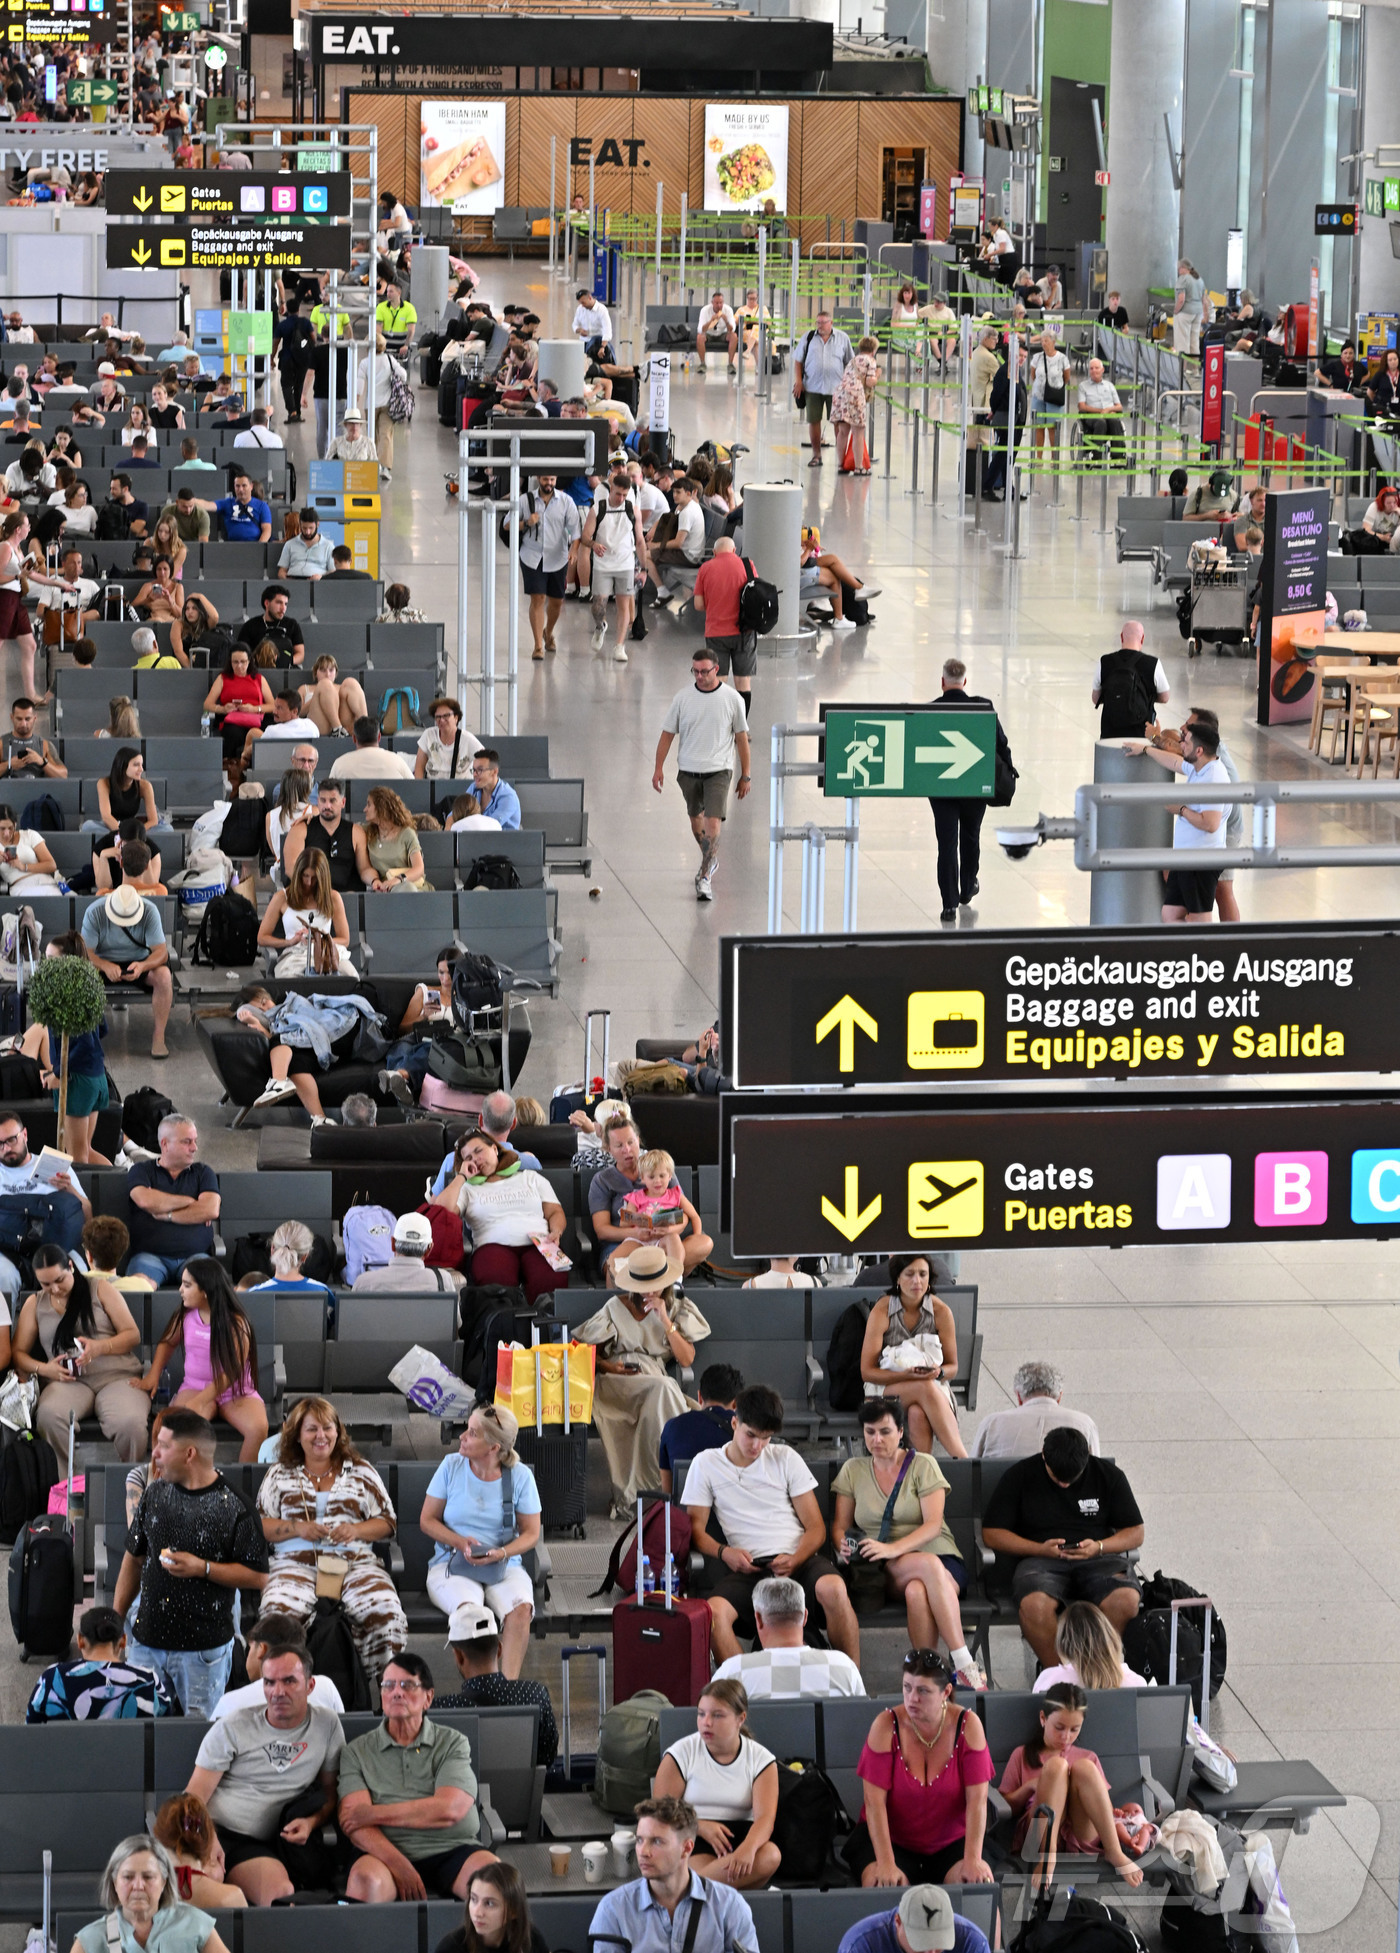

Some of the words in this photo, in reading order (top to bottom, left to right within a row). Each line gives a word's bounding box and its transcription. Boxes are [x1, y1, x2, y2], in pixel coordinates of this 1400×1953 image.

[323, 26, 400, 55] EAT.
[438, 109, 469, 118] IBERIAN
[471, 109, 488, 118] HAM
[724, 114, 745, 123] MADE
[760, 114, 770, 123] US
[41, 149, 109, 172] FREE
[570, 138, 651, 167] EAT.
[191, 187, 221, 198] Gates
[246, 190, 260, 208] A
[278, 190, 291, 208] B
[308, 190, 322, 208] C
[191, 199, 234, 211] Puertas
[191, 228, 262, 242] Gepäckausgabe
[264, 228, 304, 242] Ausgang
[192, 241, 233, 253] Baggage
[236, 242, 254, 251] and
[256, 241, 274, 252] exit
[192, 252, 250, 267] Equipajes
[253, 257, 261, 267] y
[264, 252, 302, 265] Salida
[1292, 509, 1314, 523] MENÚ
[1282, 522, 1322, 538] DESAYUNO
[1288, 585, 1304, 599] 8,50
[1306, 583, 1312, 596] €
[1005, 954, 1225, 990] Gepäckausgabe
[1233, 953, 1354, 987] Ausgang
[1006, 993, 1134, 1027] Baggage
[1145, 990, 1197, 1019] and
[1208, 988, 1260, 1018] exit
[1006, 1028, 1185, 1070] Equipajes
[1197, 1034, 1219, 1066] y
[1232, 1024, 1345, 1059] Salida
[1004, 1163, 1094, 1192] Gates
[1172, 1165, 1215, 1218] A
[1274, 1163, 1312, 1215] B
[1368, 1160, 1400, 1212] C
[1004, 1200, 1133, 1232] Puertas
[269, 1744, 299, 1753] PARIS
